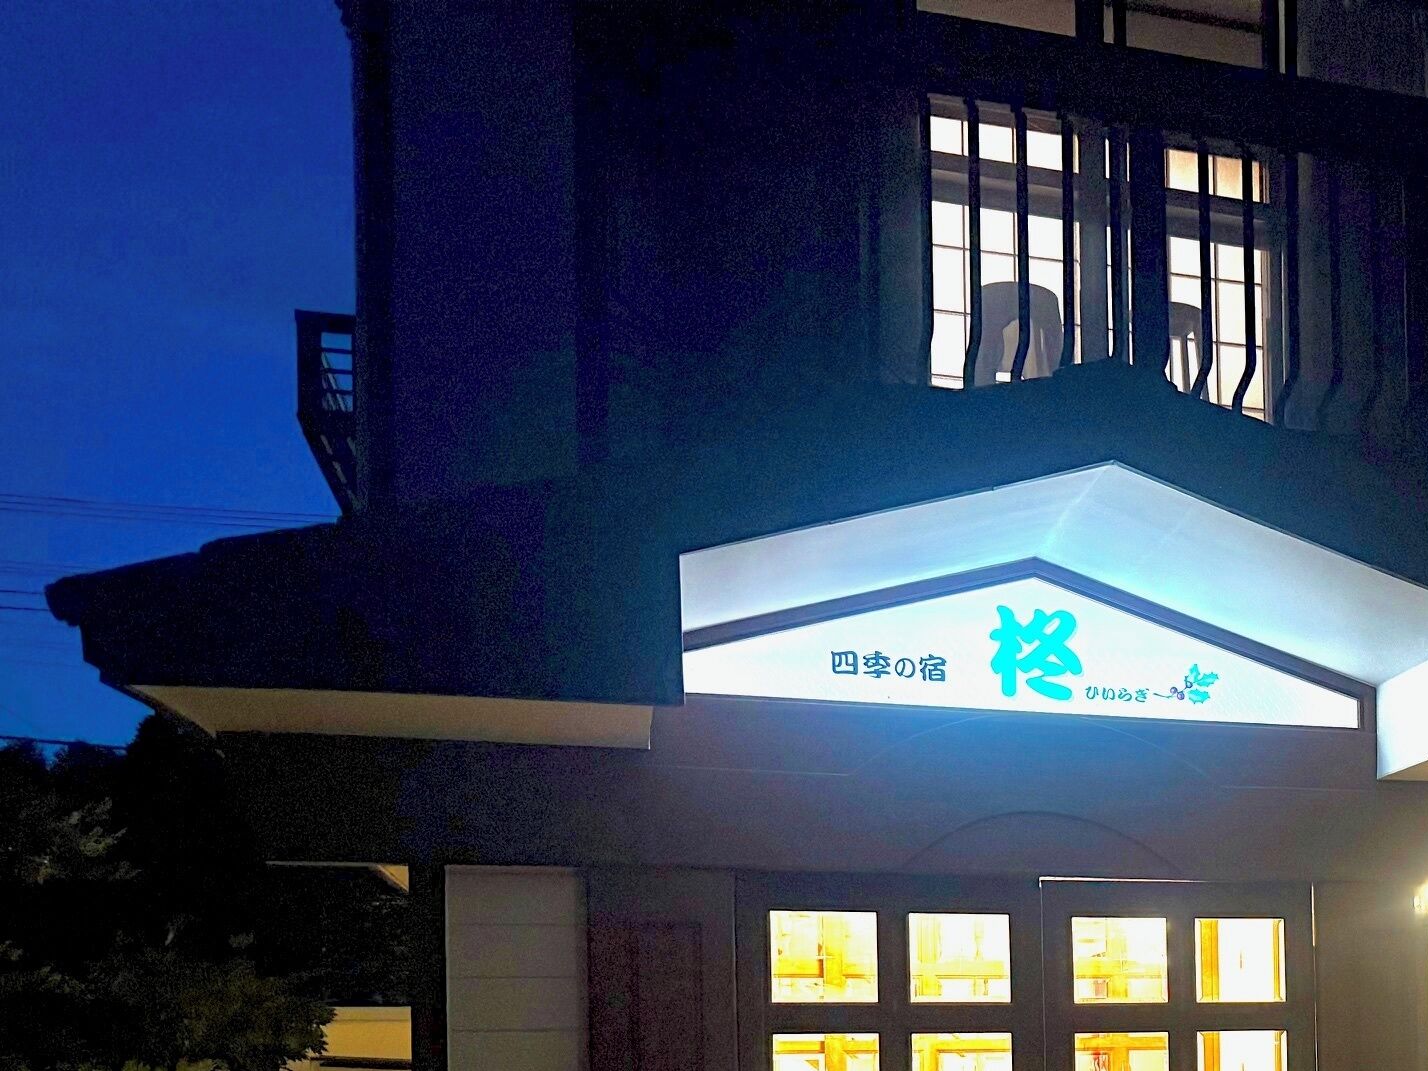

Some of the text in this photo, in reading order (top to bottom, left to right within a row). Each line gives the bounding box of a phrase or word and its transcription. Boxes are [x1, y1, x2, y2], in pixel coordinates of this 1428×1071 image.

[830, 650, 946, 682] 四季の宿
[989, 605, 1083, 701] 柊
[1085, 685, 1151, 703] ひいらぎ
